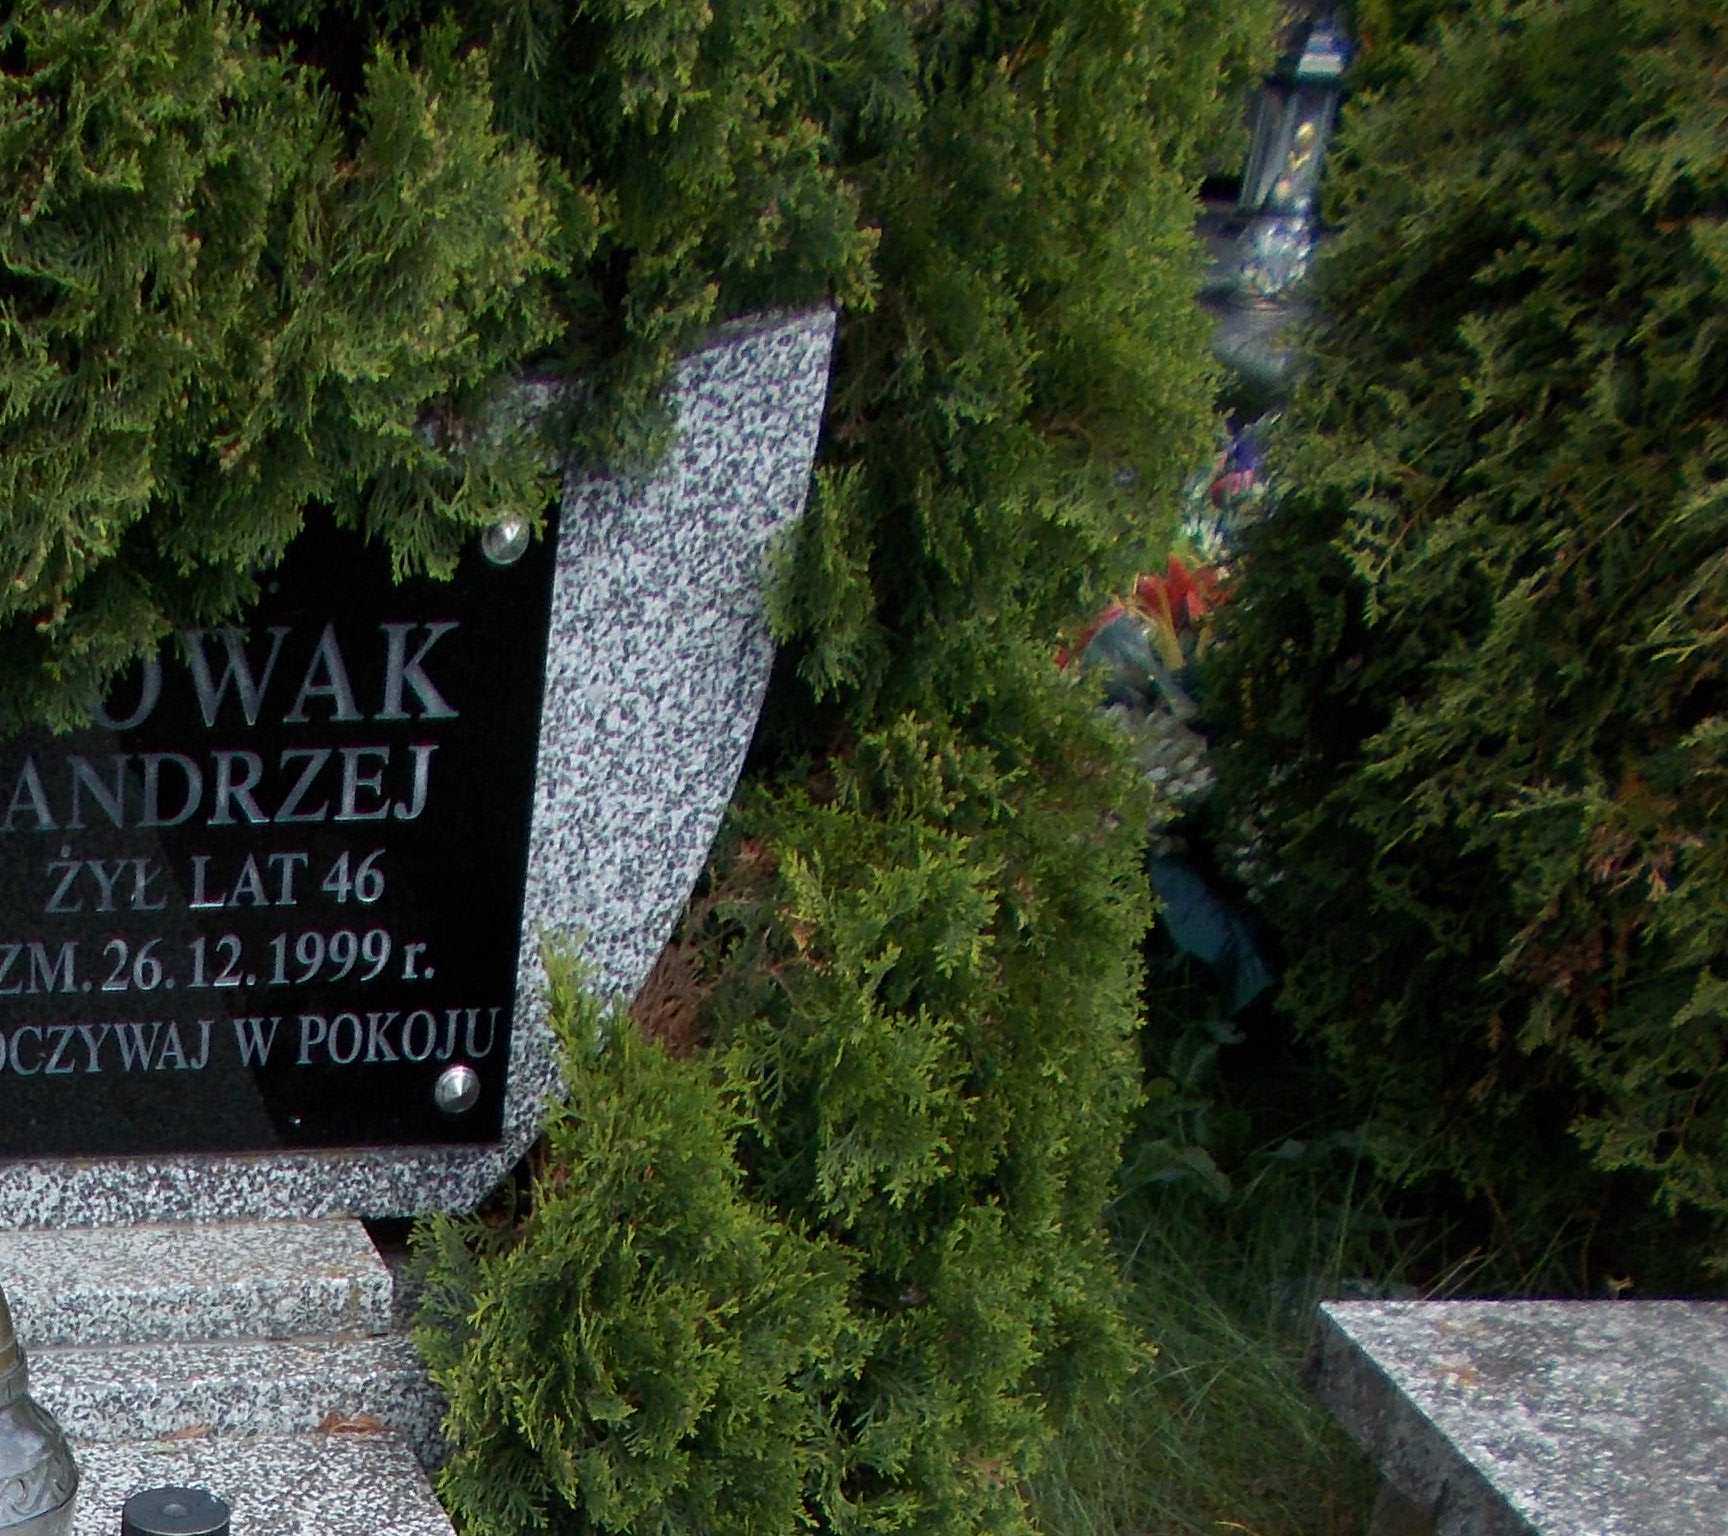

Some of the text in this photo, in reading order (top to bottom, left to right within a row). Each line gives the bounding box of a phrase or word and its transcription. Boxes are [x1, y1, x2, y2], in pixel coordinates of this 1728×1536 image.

[45, 844, 387, 913] ŻYŁ LAT 46
[401, 937, 437, 981] r.
[233, 1018, 282, 1067] W
[294, 1007, 502, 1066] POKOJU
